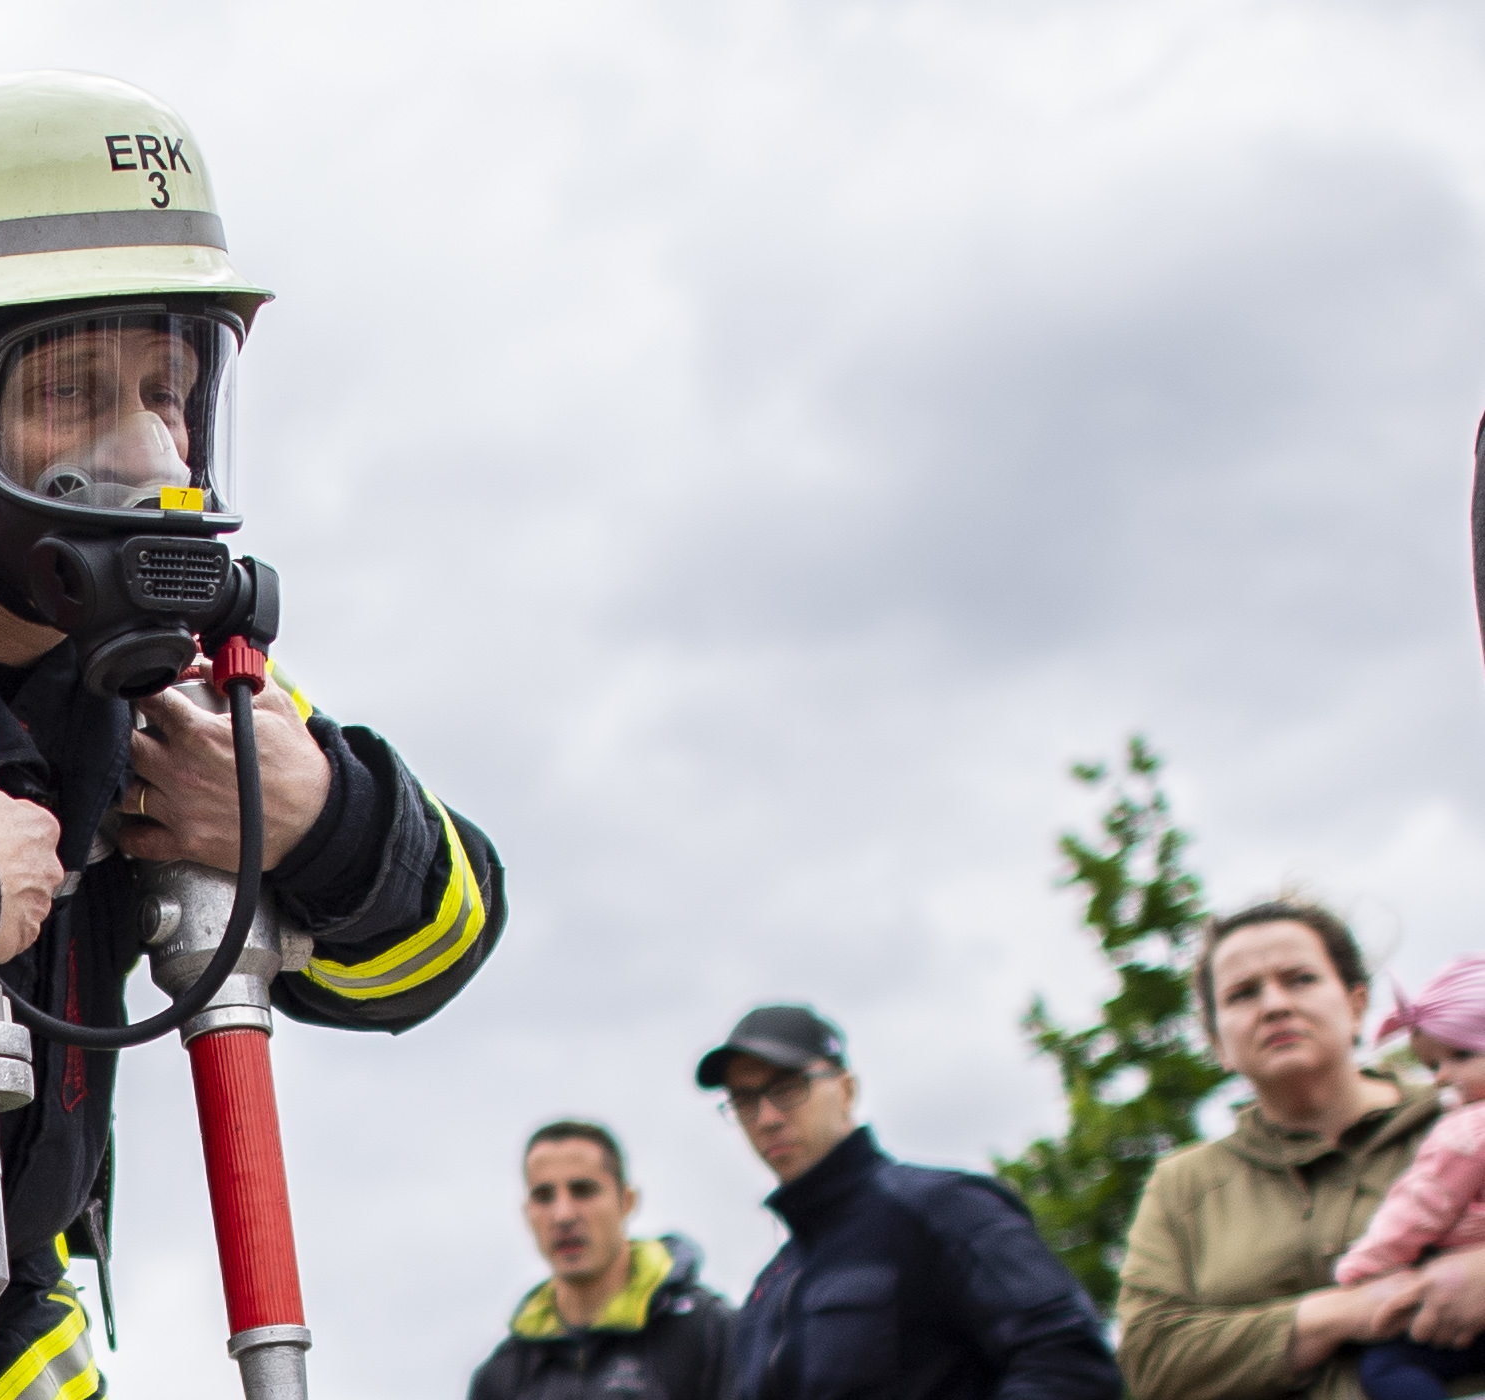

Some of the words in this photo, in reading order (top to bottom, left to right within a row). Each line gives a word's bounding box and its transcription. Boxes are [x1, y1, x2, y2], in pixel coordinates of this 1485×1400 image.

[105, 134, 192, 174] ERK
[148, 171, 170, 209] 3
[179, 490, 188, 506] 7
